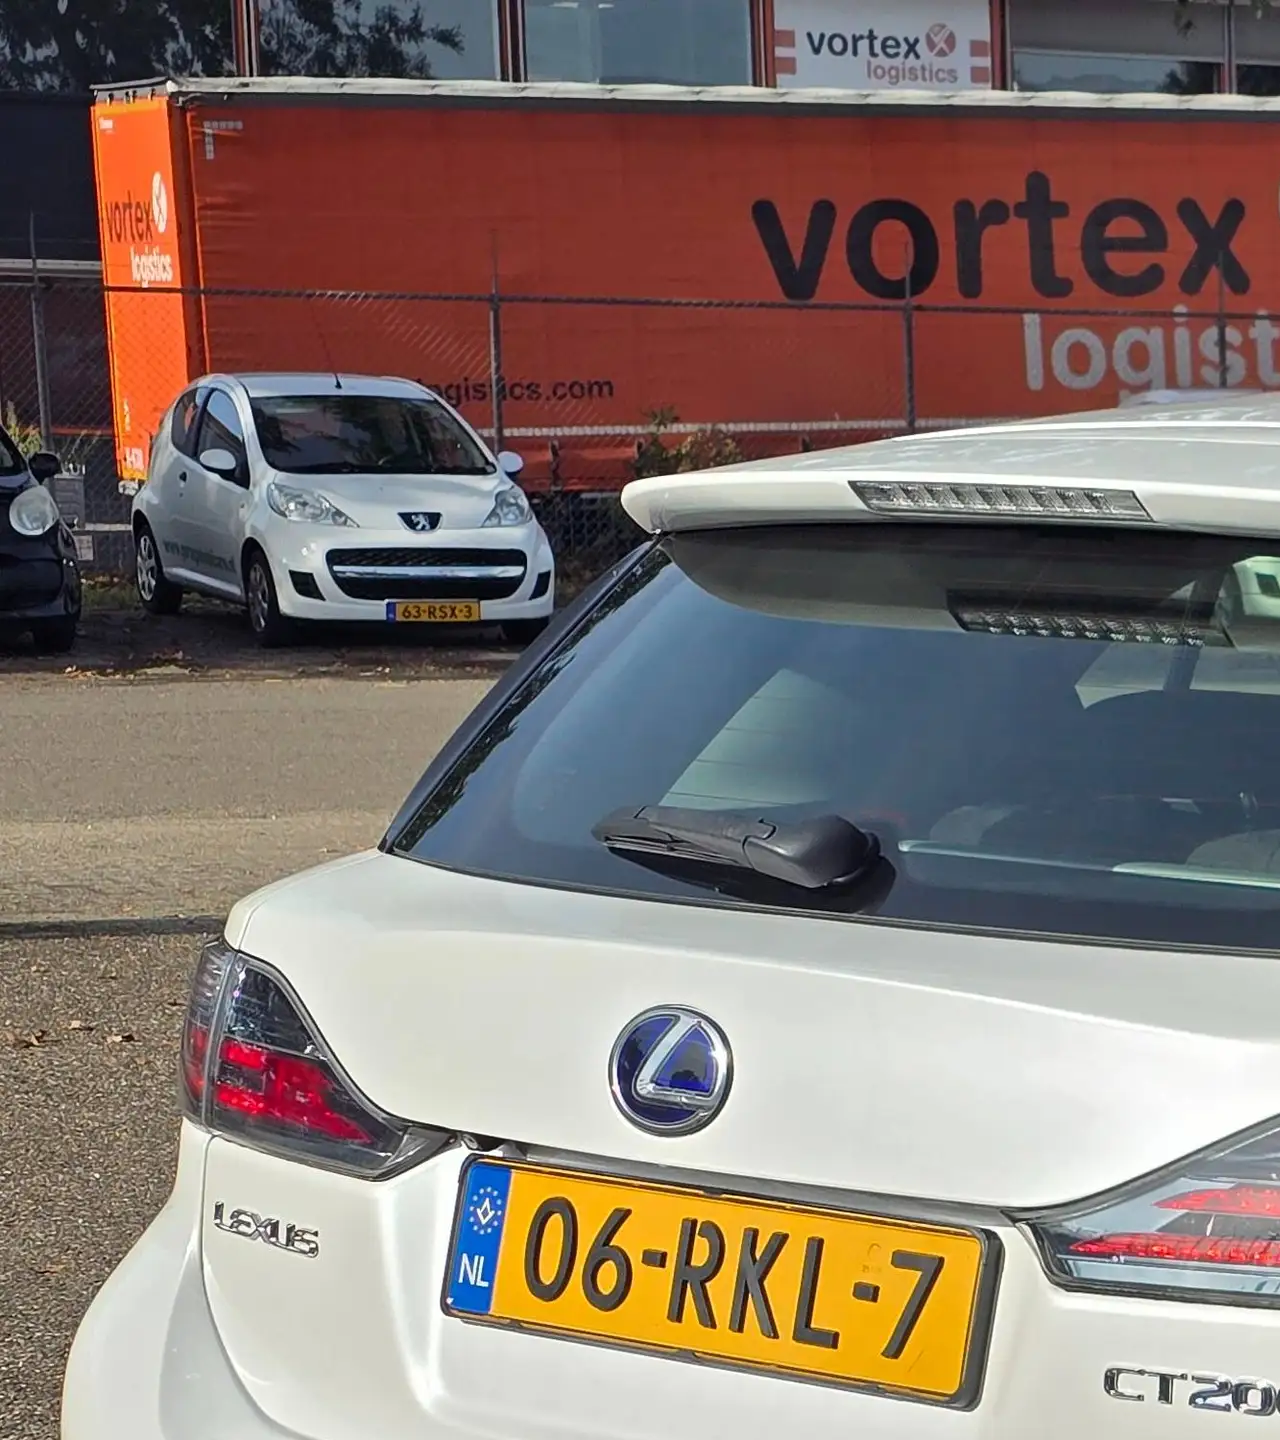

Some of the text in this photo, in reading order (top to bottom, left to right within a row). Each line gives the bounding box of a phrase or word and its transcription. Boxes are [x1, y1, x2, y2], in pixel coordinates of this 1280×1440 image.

[806, 28, 920, 60] vortex
[867, 60, 958, 85] logistics
[105, 191, 153, 242] vortex
[751, 170, 1250, 300] vortex
[131, 247, 173, 288] logistics
[402, 604, 472, 619] 63-RSX-3
[214, 1201, 319, 1258] LEXUS
[458, 1253, 489, 1287] NL
[523, 1196, 945, 1360] 06-RKL-7
